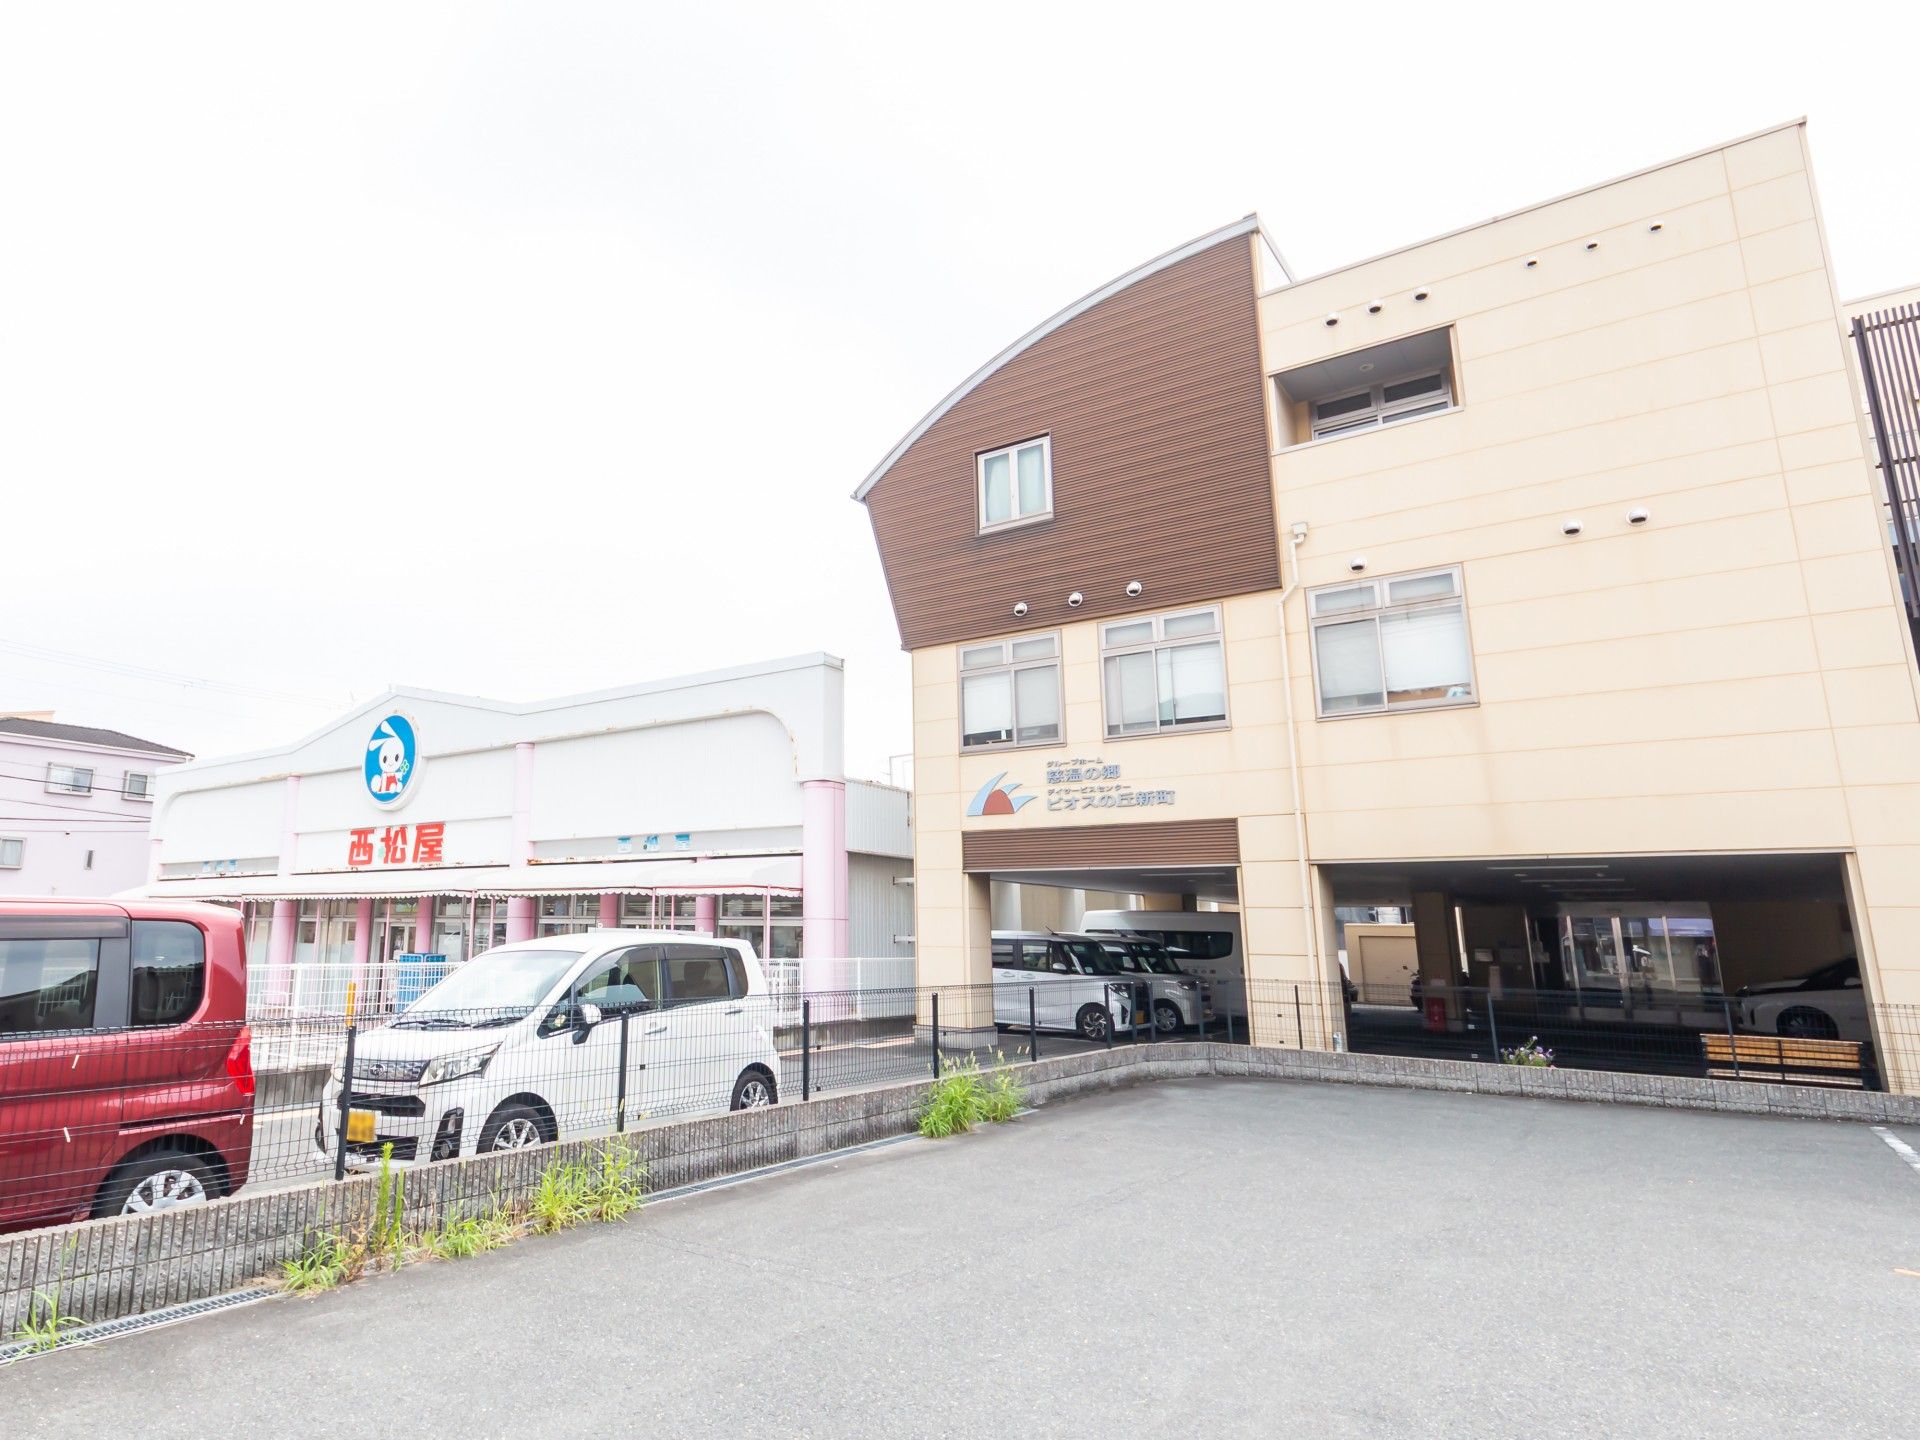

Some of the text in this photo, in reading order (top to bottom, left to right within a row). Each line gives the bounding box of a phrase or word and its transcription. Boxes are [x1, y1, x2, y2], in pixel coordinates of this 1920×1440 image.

[1047, 758, 1103, 768] グループホーム
[1048, 785, 1131, 796] デイサービスセンター
[348, 821, 446, 866] 西松屋
